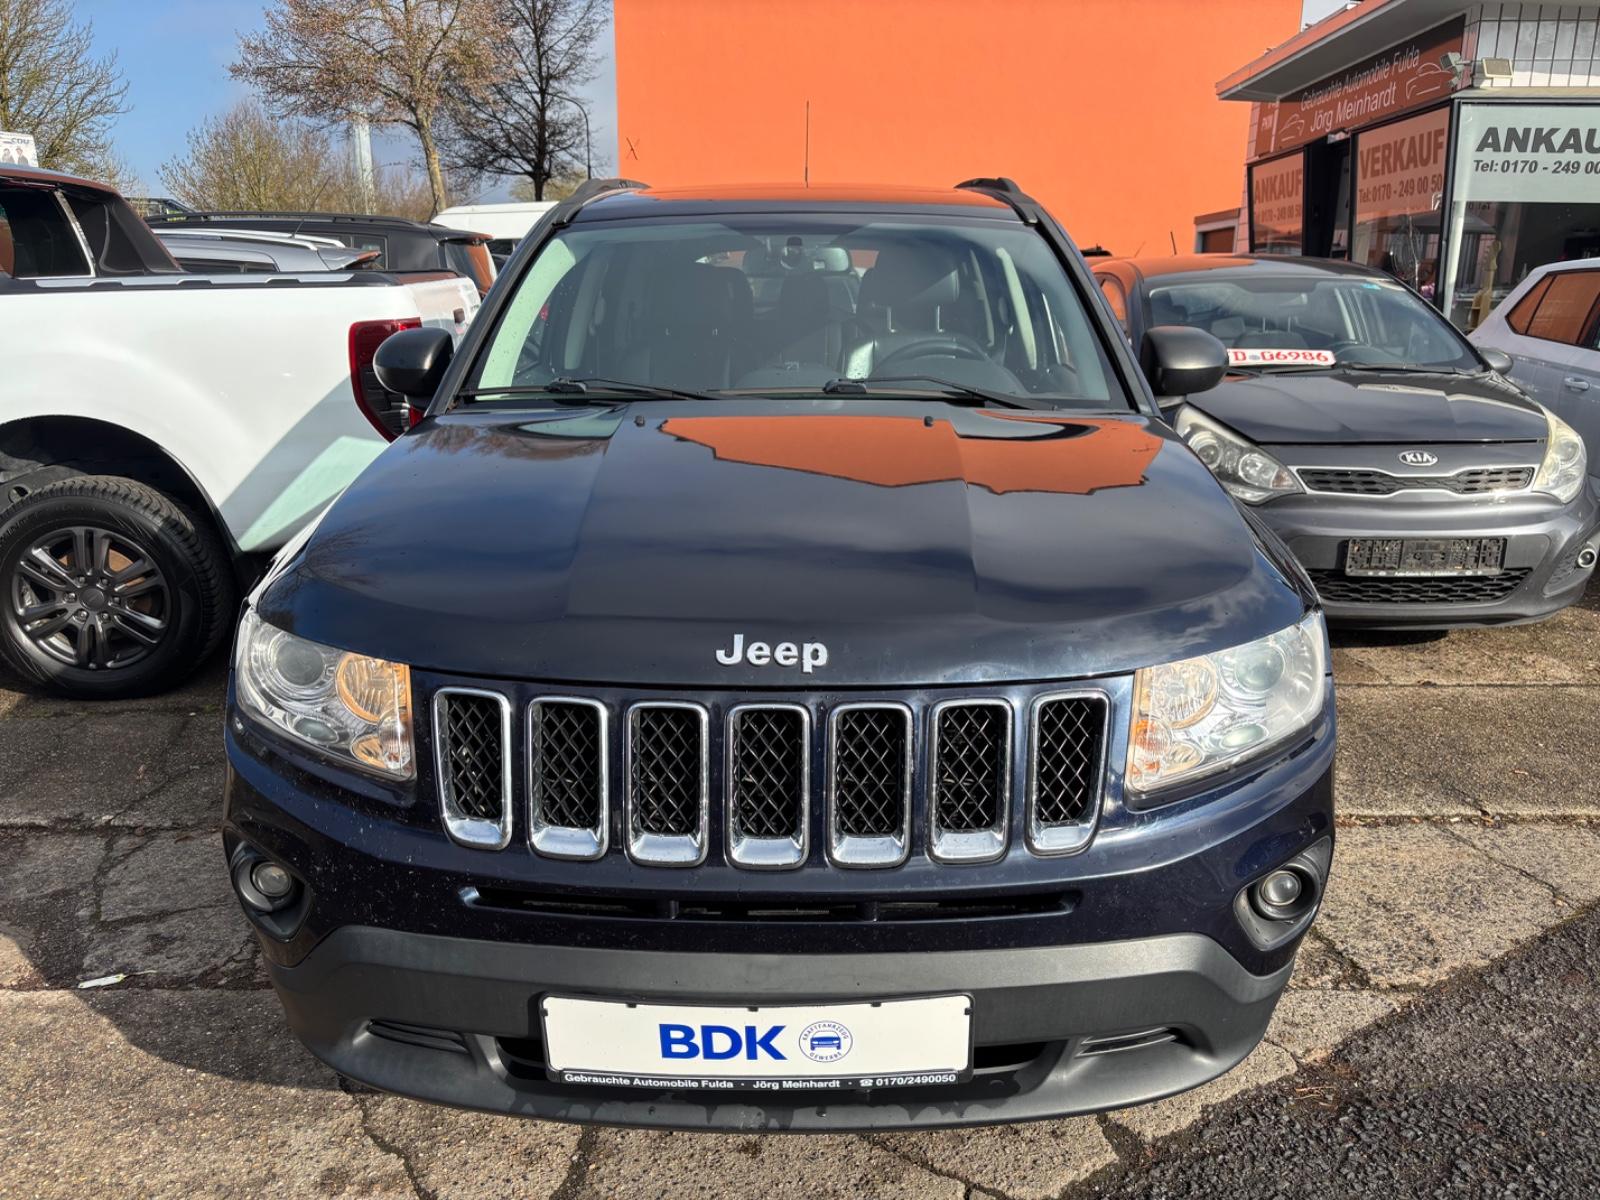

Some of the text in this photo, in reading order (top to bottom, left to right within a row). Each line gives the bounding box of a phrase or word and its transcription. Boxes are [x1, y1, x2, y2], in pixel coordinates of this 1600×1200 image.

[1301, 44, 1420, 111] Gebrauchte Automobile Fulda
[1310, 81, 1397, 132] Jörg Meinhardt
[1360, 128, 1445, 180] VERKAUF
[1473, 160, 1498, 172] Tel:
[1500, 160, 1538, 174] 0170
[1551, 161, 1581, 175] 249
[1254, 168, 1302, 204] ANKAUF
[1371, 183, 1392, 202] 0170
[1398, 178, 1415, 198] 249
[1416, 175, 1428, 195] 00
[1431, 173, 1443, 193] 50
[1405, 452, 1434, 463] KIA
[715, 633, 829, 673] Jeep
[658, 1023, 788, 1061] BDK
[564, 1073, 956, 1090] Gebrauchte Automobile Fulda Jörg Meinhardt 0170/2490050
